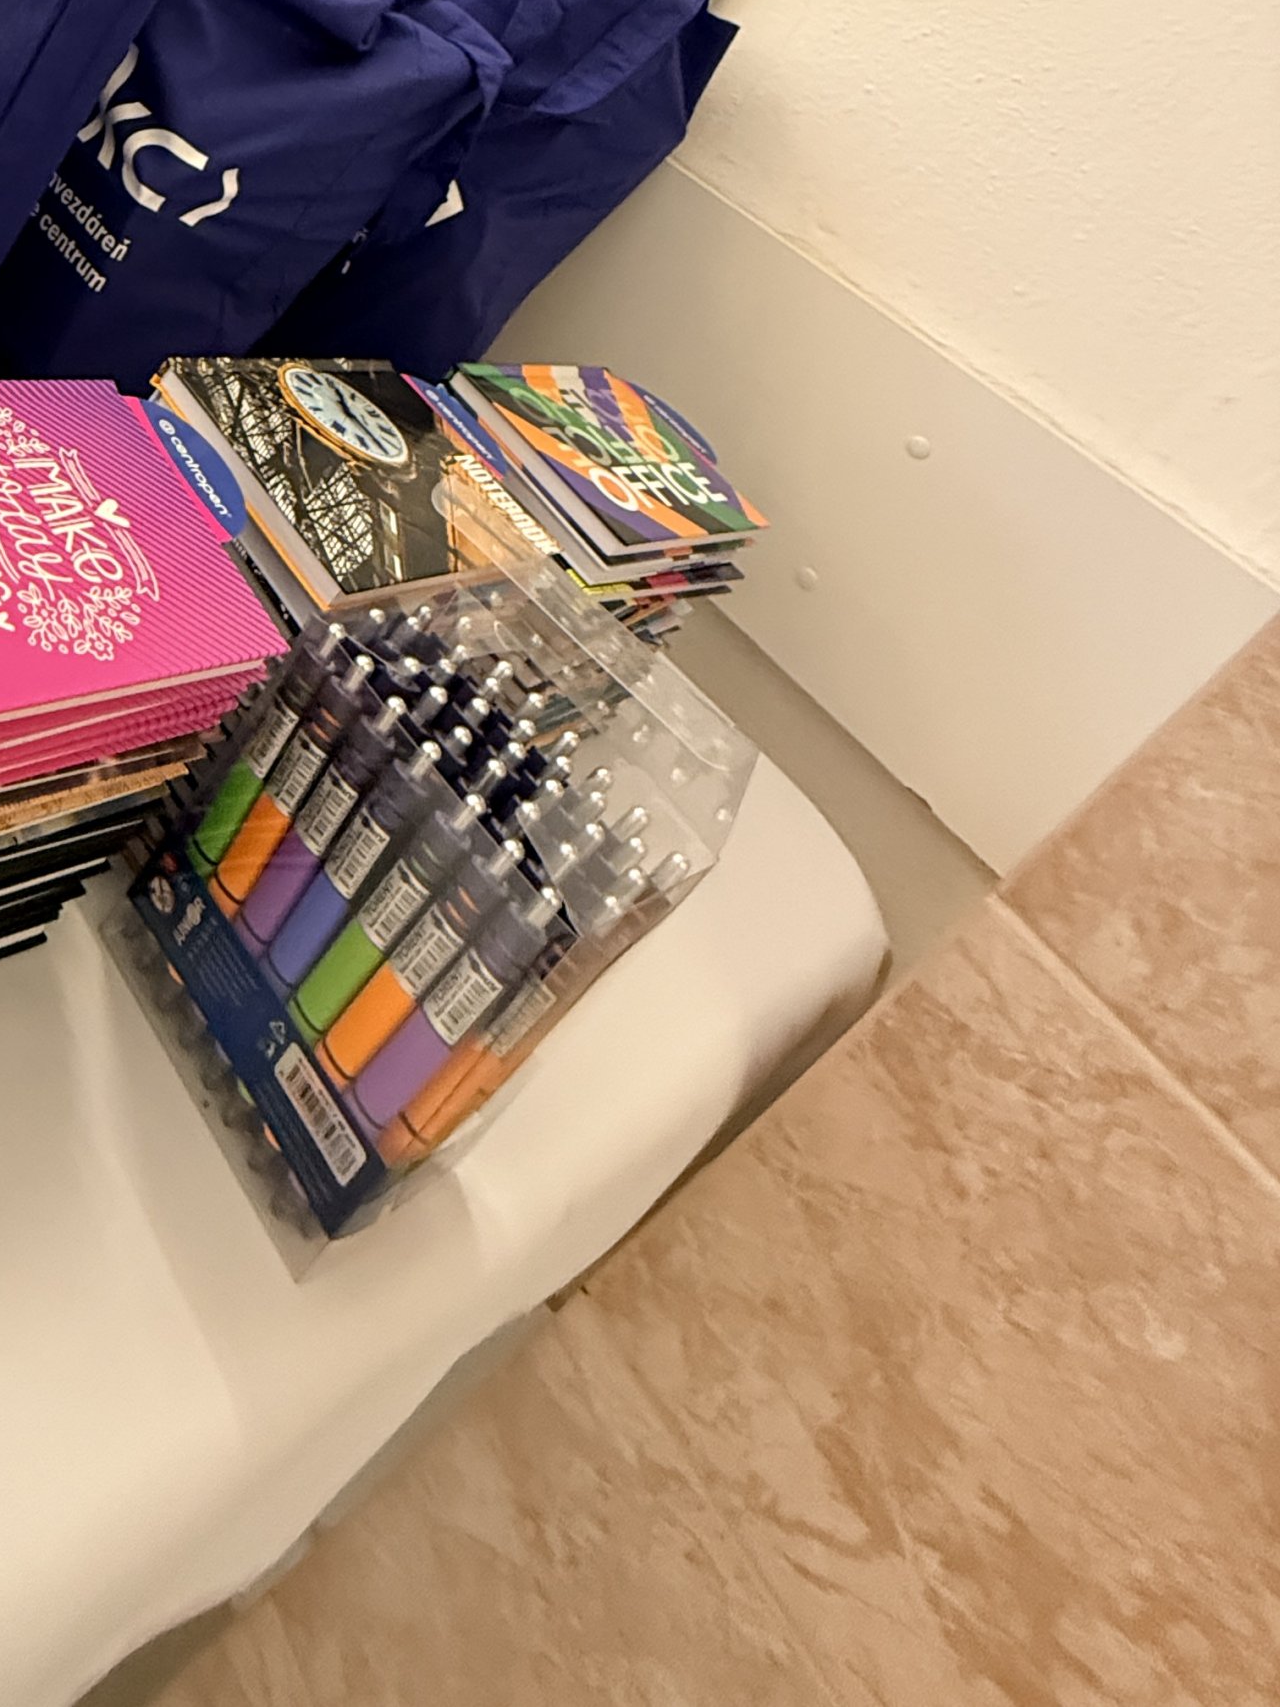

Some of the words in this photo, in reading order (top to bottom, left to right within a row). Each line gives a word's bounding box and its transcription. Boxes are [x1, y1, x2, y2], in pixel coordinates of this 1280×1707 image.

[39, 215, 107, 293] centrum
[170, 432, 230, 517] centropen
[588, 461, 729, 513] OFFICE
